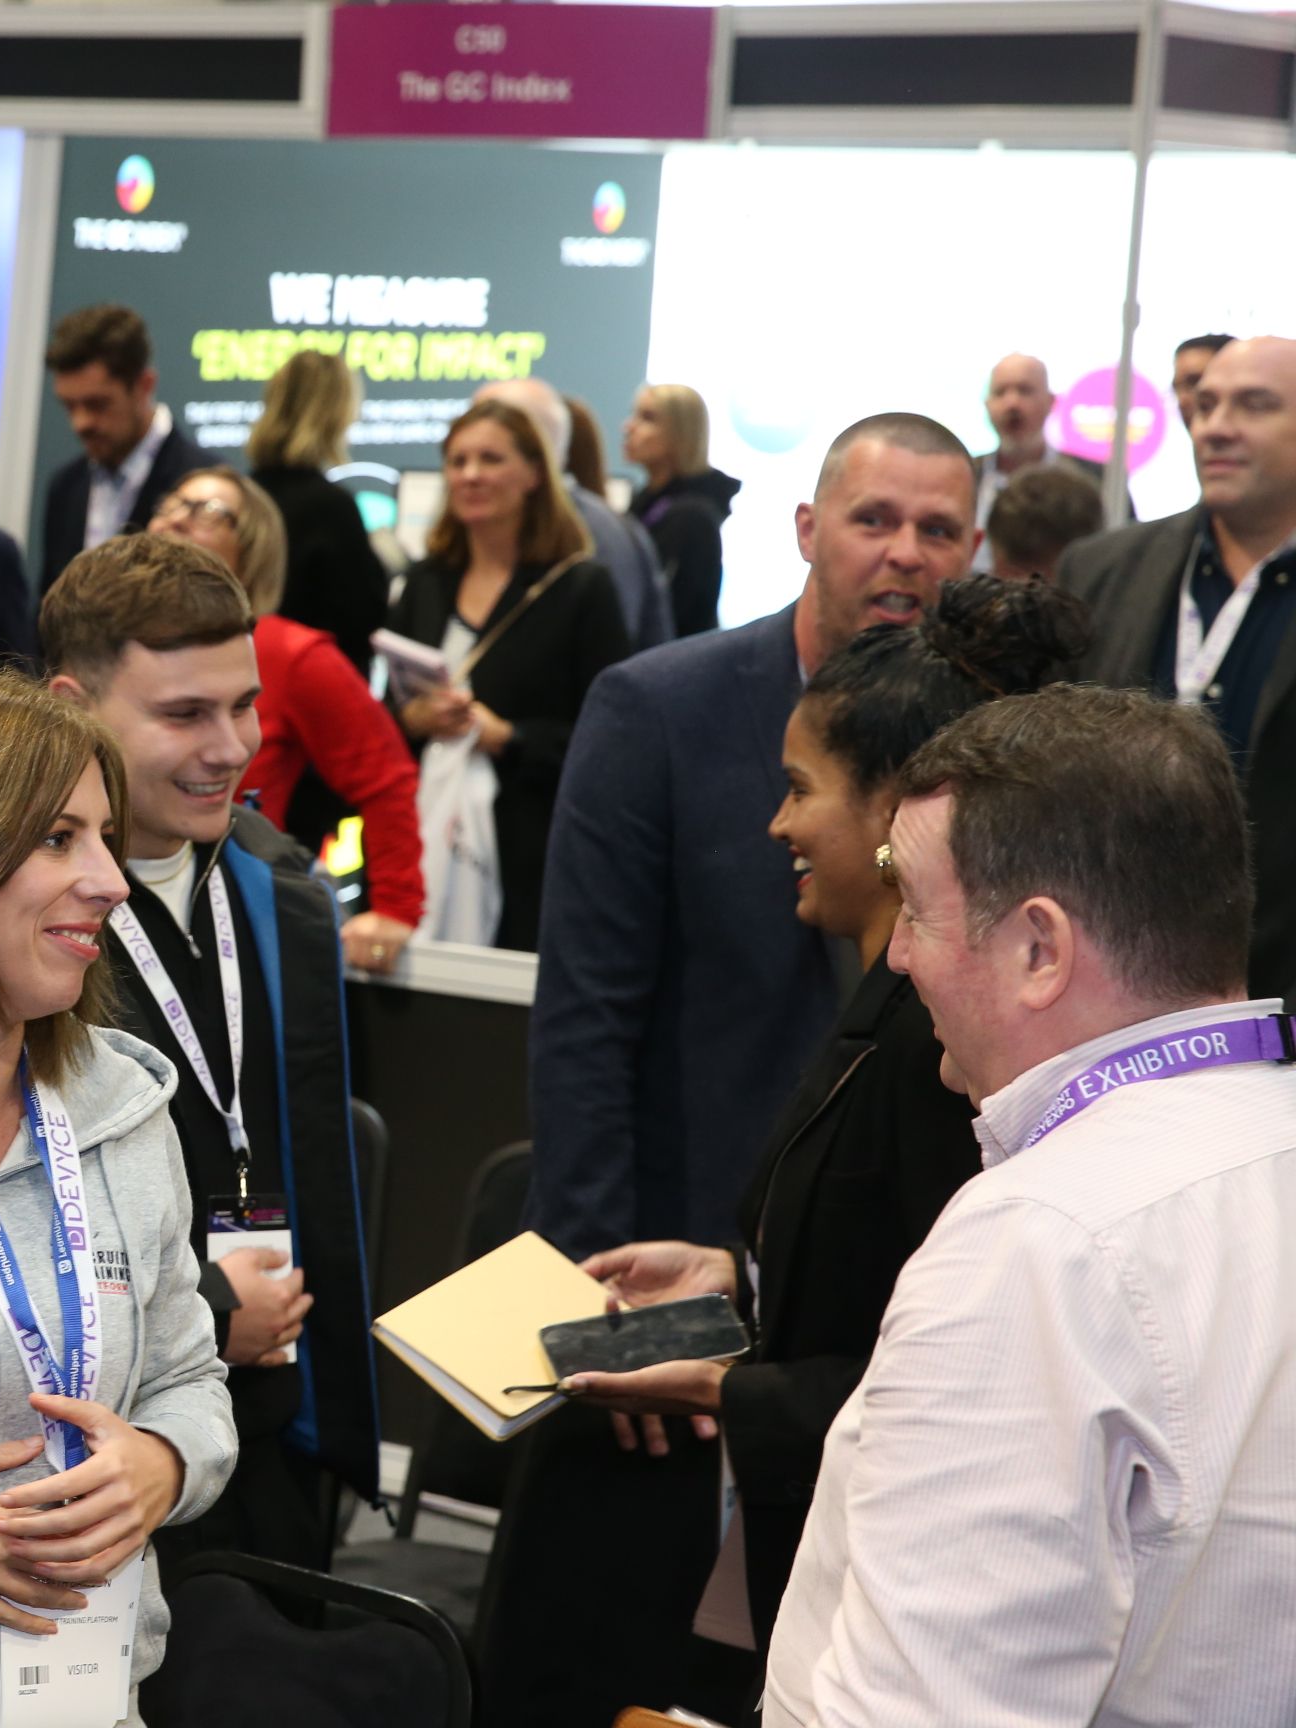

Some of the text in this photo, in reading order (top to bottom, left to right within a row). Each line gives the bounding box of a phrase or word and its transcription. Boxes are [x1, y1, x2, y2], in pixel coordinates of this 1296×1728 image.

[399, 71, 442, 102] The
[490, 73, 572, 102] Index
[269, 272, 332, 325] WE
[1078, 1032, 1230, 1099] EXHIBITOR
[67, 1663, 99, 1676] VISITOR
